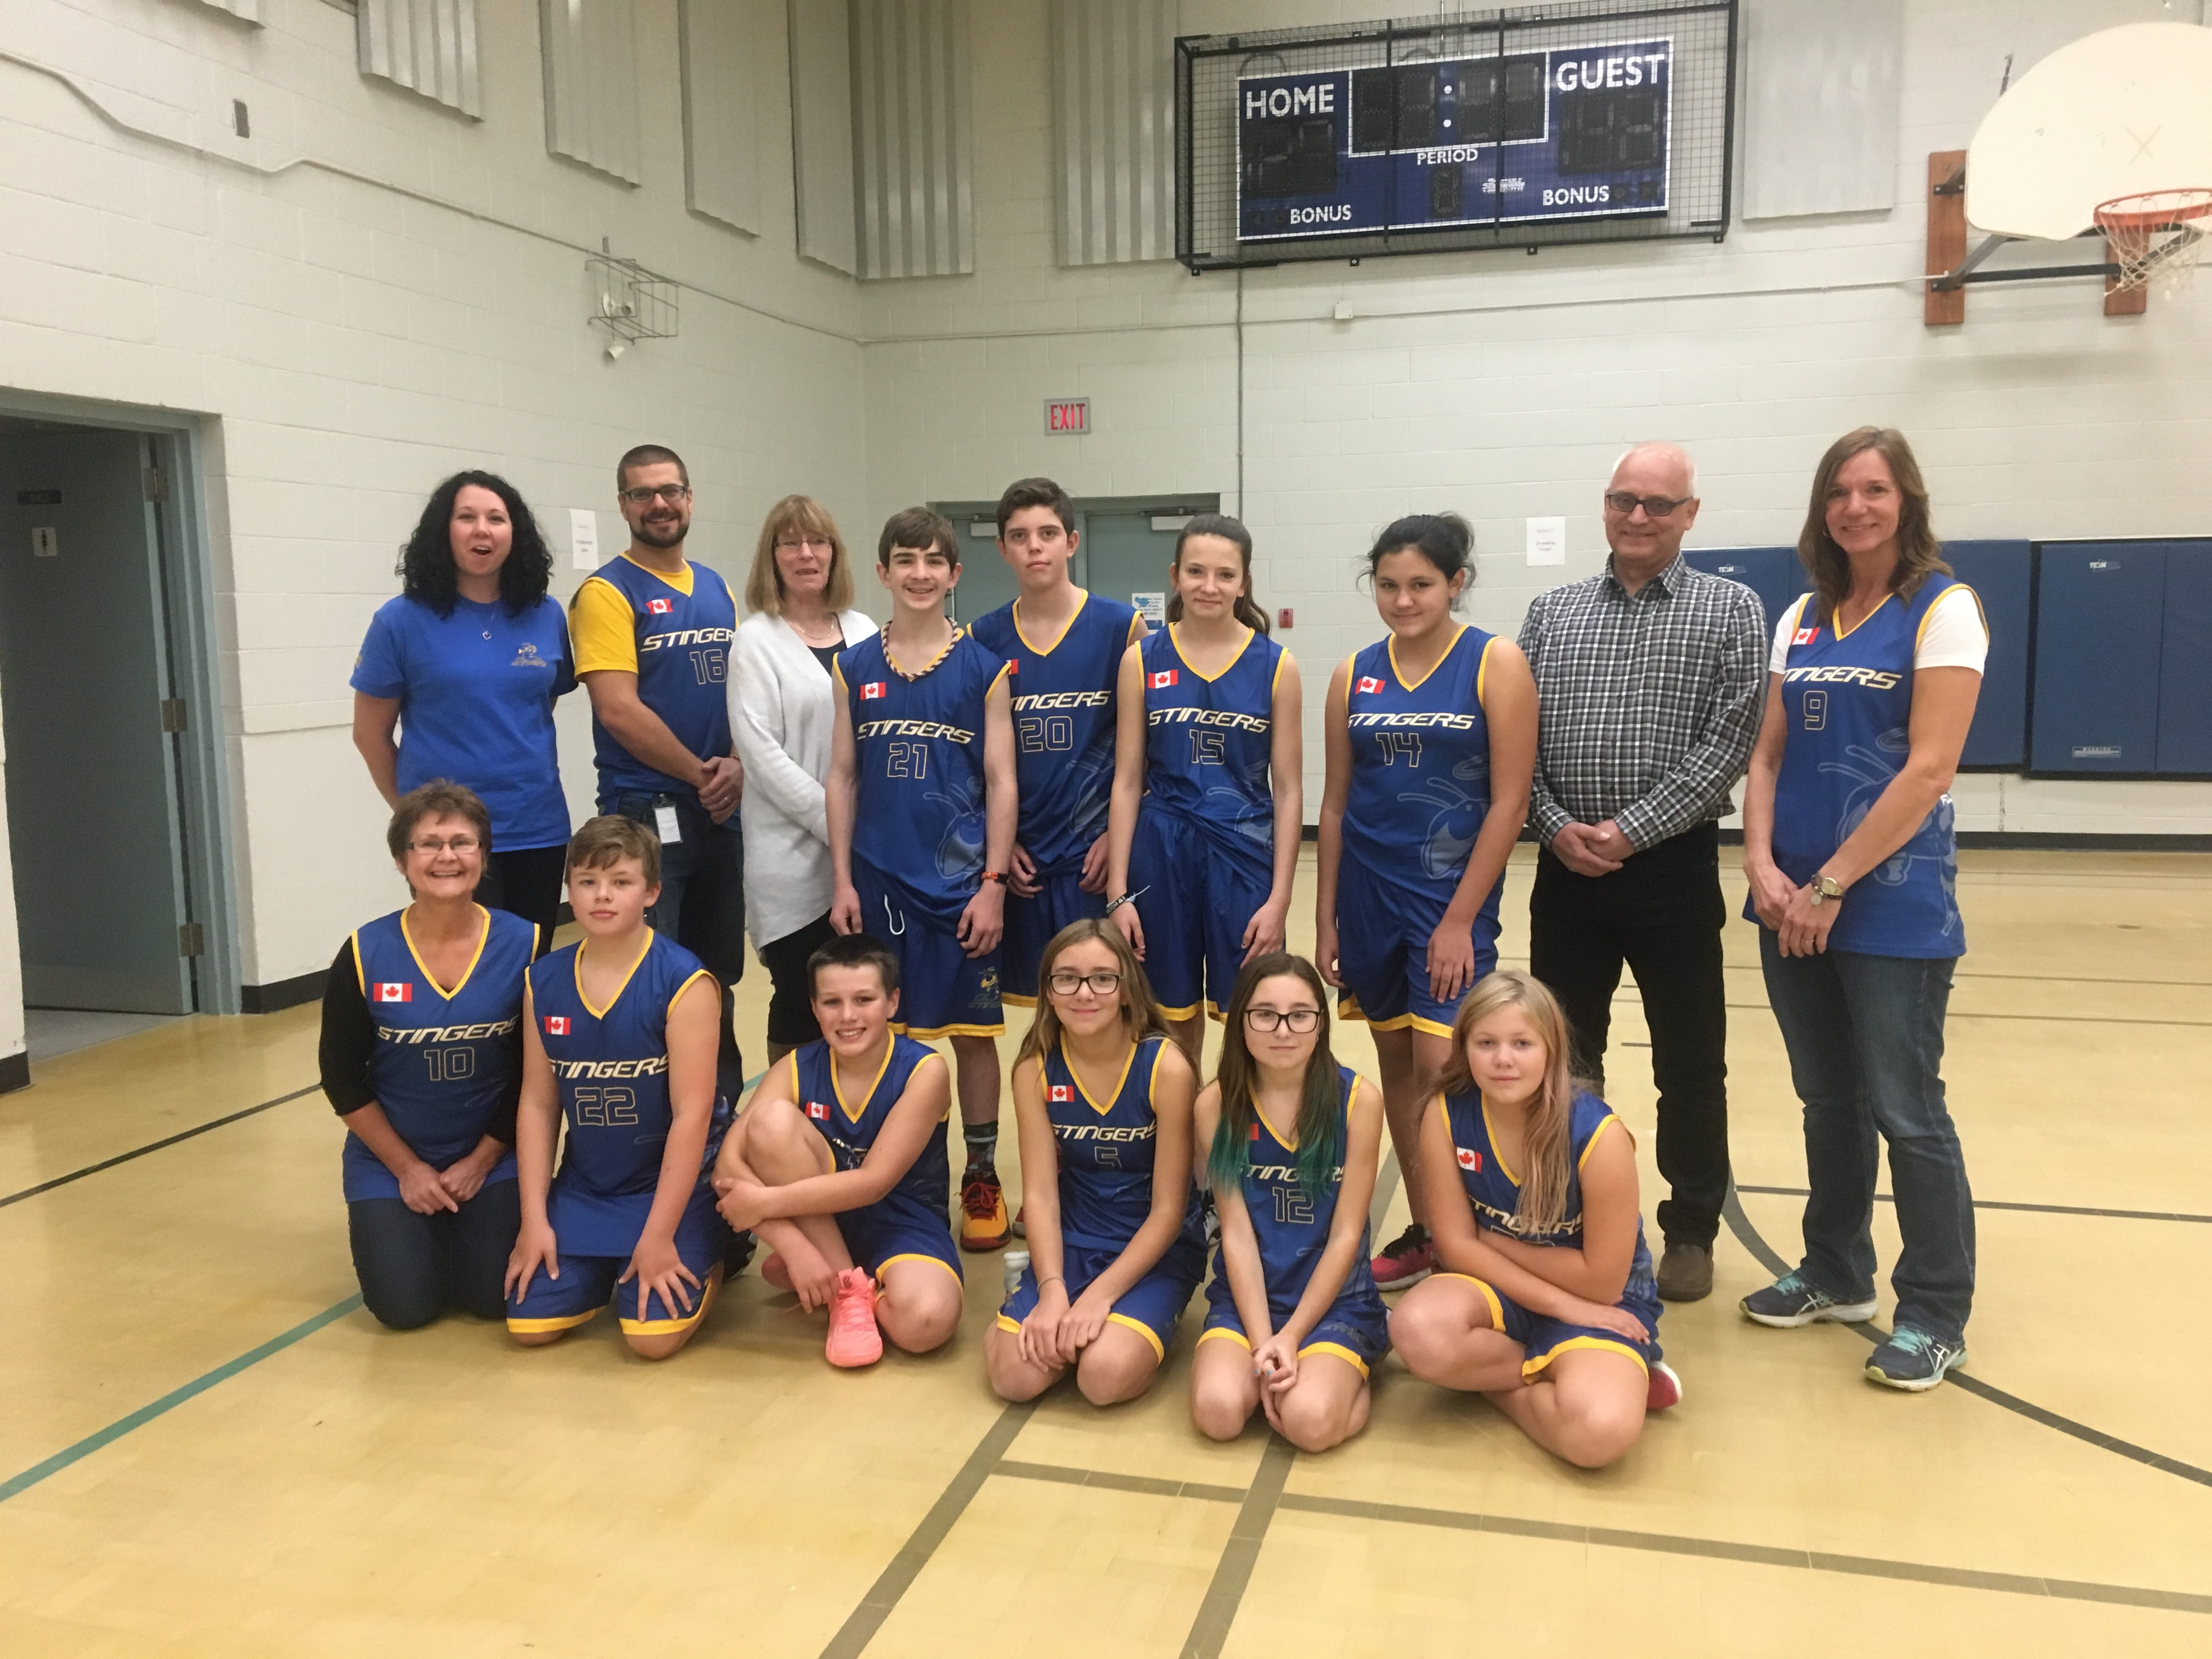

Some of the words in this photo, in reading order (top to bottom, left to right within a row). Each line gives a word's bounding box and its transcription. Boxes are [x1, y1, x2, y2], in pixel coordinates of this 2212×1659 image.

[1556, 54, 1665, 91] GUEST
[1246, 84, 1334, 119] HOME
[1417, 148, 1479, 165] PERIOD
[1543, 185, 1610, 206] BONUS
[1290, 205, 1352, 224] BONUS
[1050, 403, 1085, 430] EXIT
[640, 628, 734, 652] STINGER
[689, 648, 726, 685] 16
[1782, 667, 1903, 689] TINGERS
[1011, 691, 1112, 711] INGERS
[1803, 690, 1827, 730] 9
[857, 719, 975, 744] STINGERS
[1019, 715, 1073, 753] 20
[1149, 707, 1270, 733] STINGERS
[887, 742, 928, 779] 21
[1189, 729, 1224, 765] 15
[1375, 732, 1422, 768] 14
[378, 1014, 520, 1044] STINGERS
[424, 1046, 475, 1081] 10
[575, 1087, 639, 1126] 22
[1272, 1187, 1314, 1224] 12
